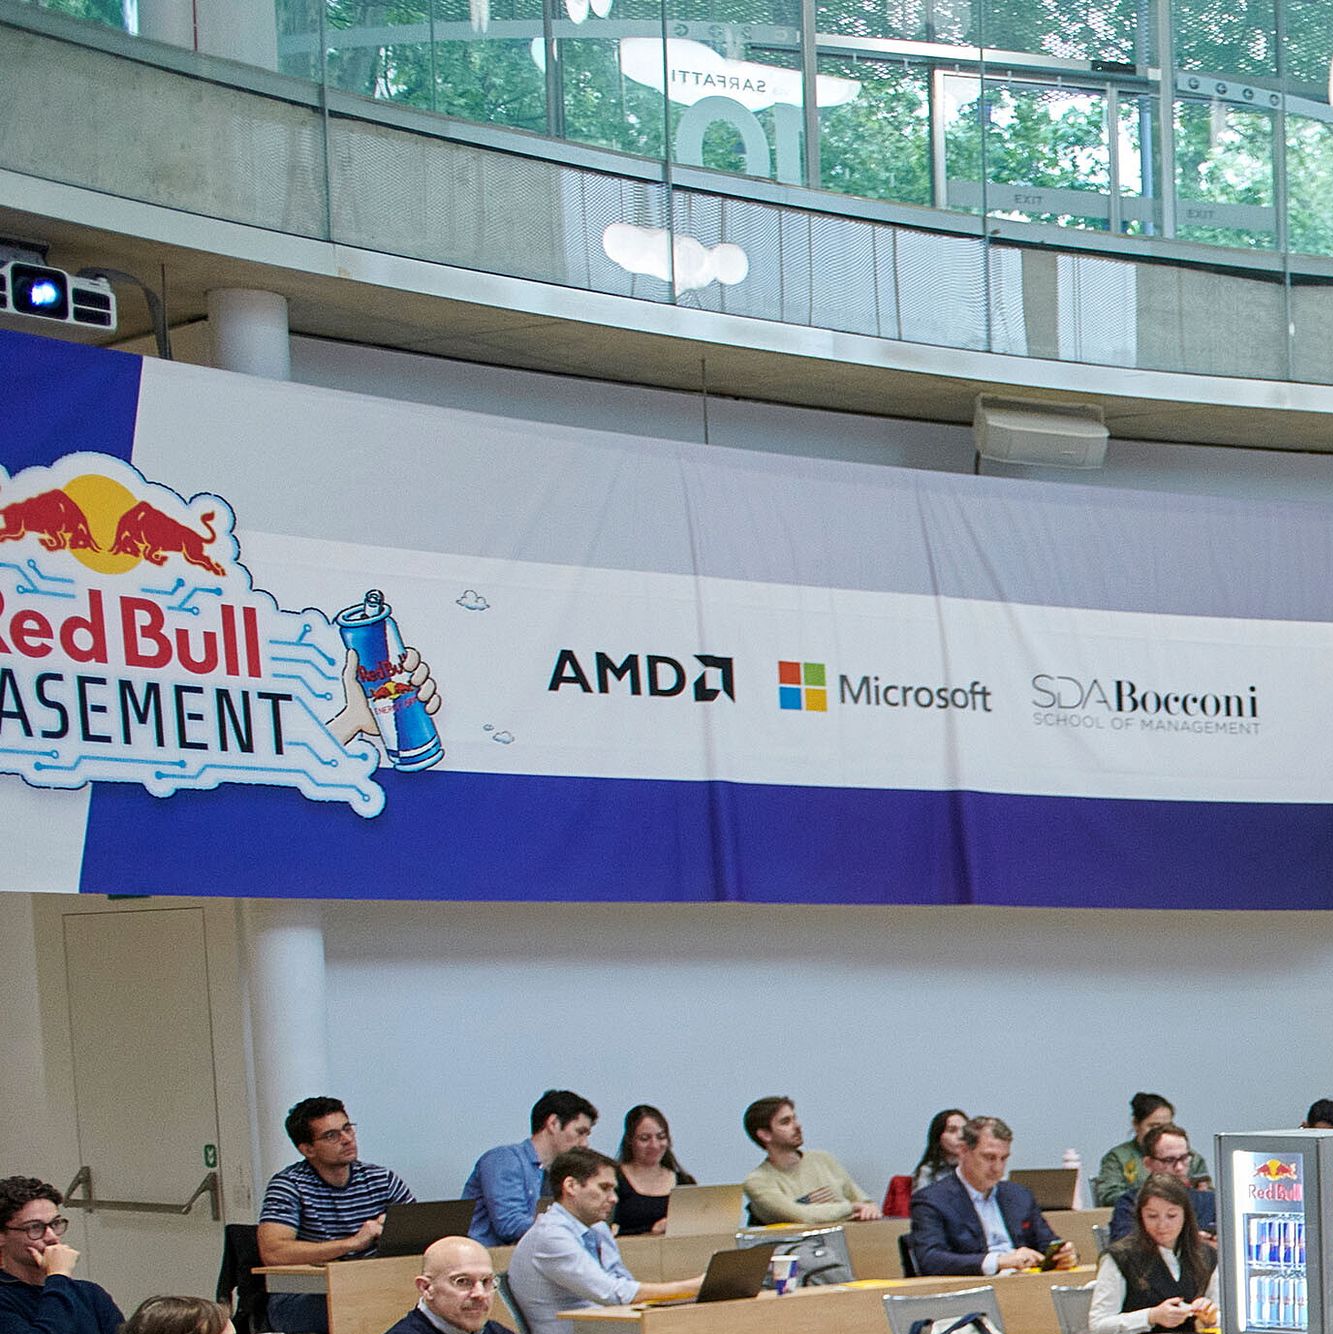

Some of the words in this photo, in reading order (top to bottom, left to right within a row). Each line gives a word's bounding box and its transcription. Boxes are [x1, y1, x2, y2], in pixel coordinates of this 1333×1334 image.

[1014, 193, 1042, 205] EXIT
[1186, 209, 1215, 219] EXIT
[0, 588, 108, 664] ed
[119, 595, 262, 678] Bull
[548, 650, 686, 698] AMD
[839, 673, 992, 712] Microsoft
[0, 668, 293, 755] ASEMENT
[1032, 713, 1104, 729] SCHOOL
[1111, 717, 1133, 730] OF
[1140, 720, 1261, 735] MANAGEMENT
[1249, 1184, 1274, 1200] Red
[1277, 1184, 1303, 1201] Bull
